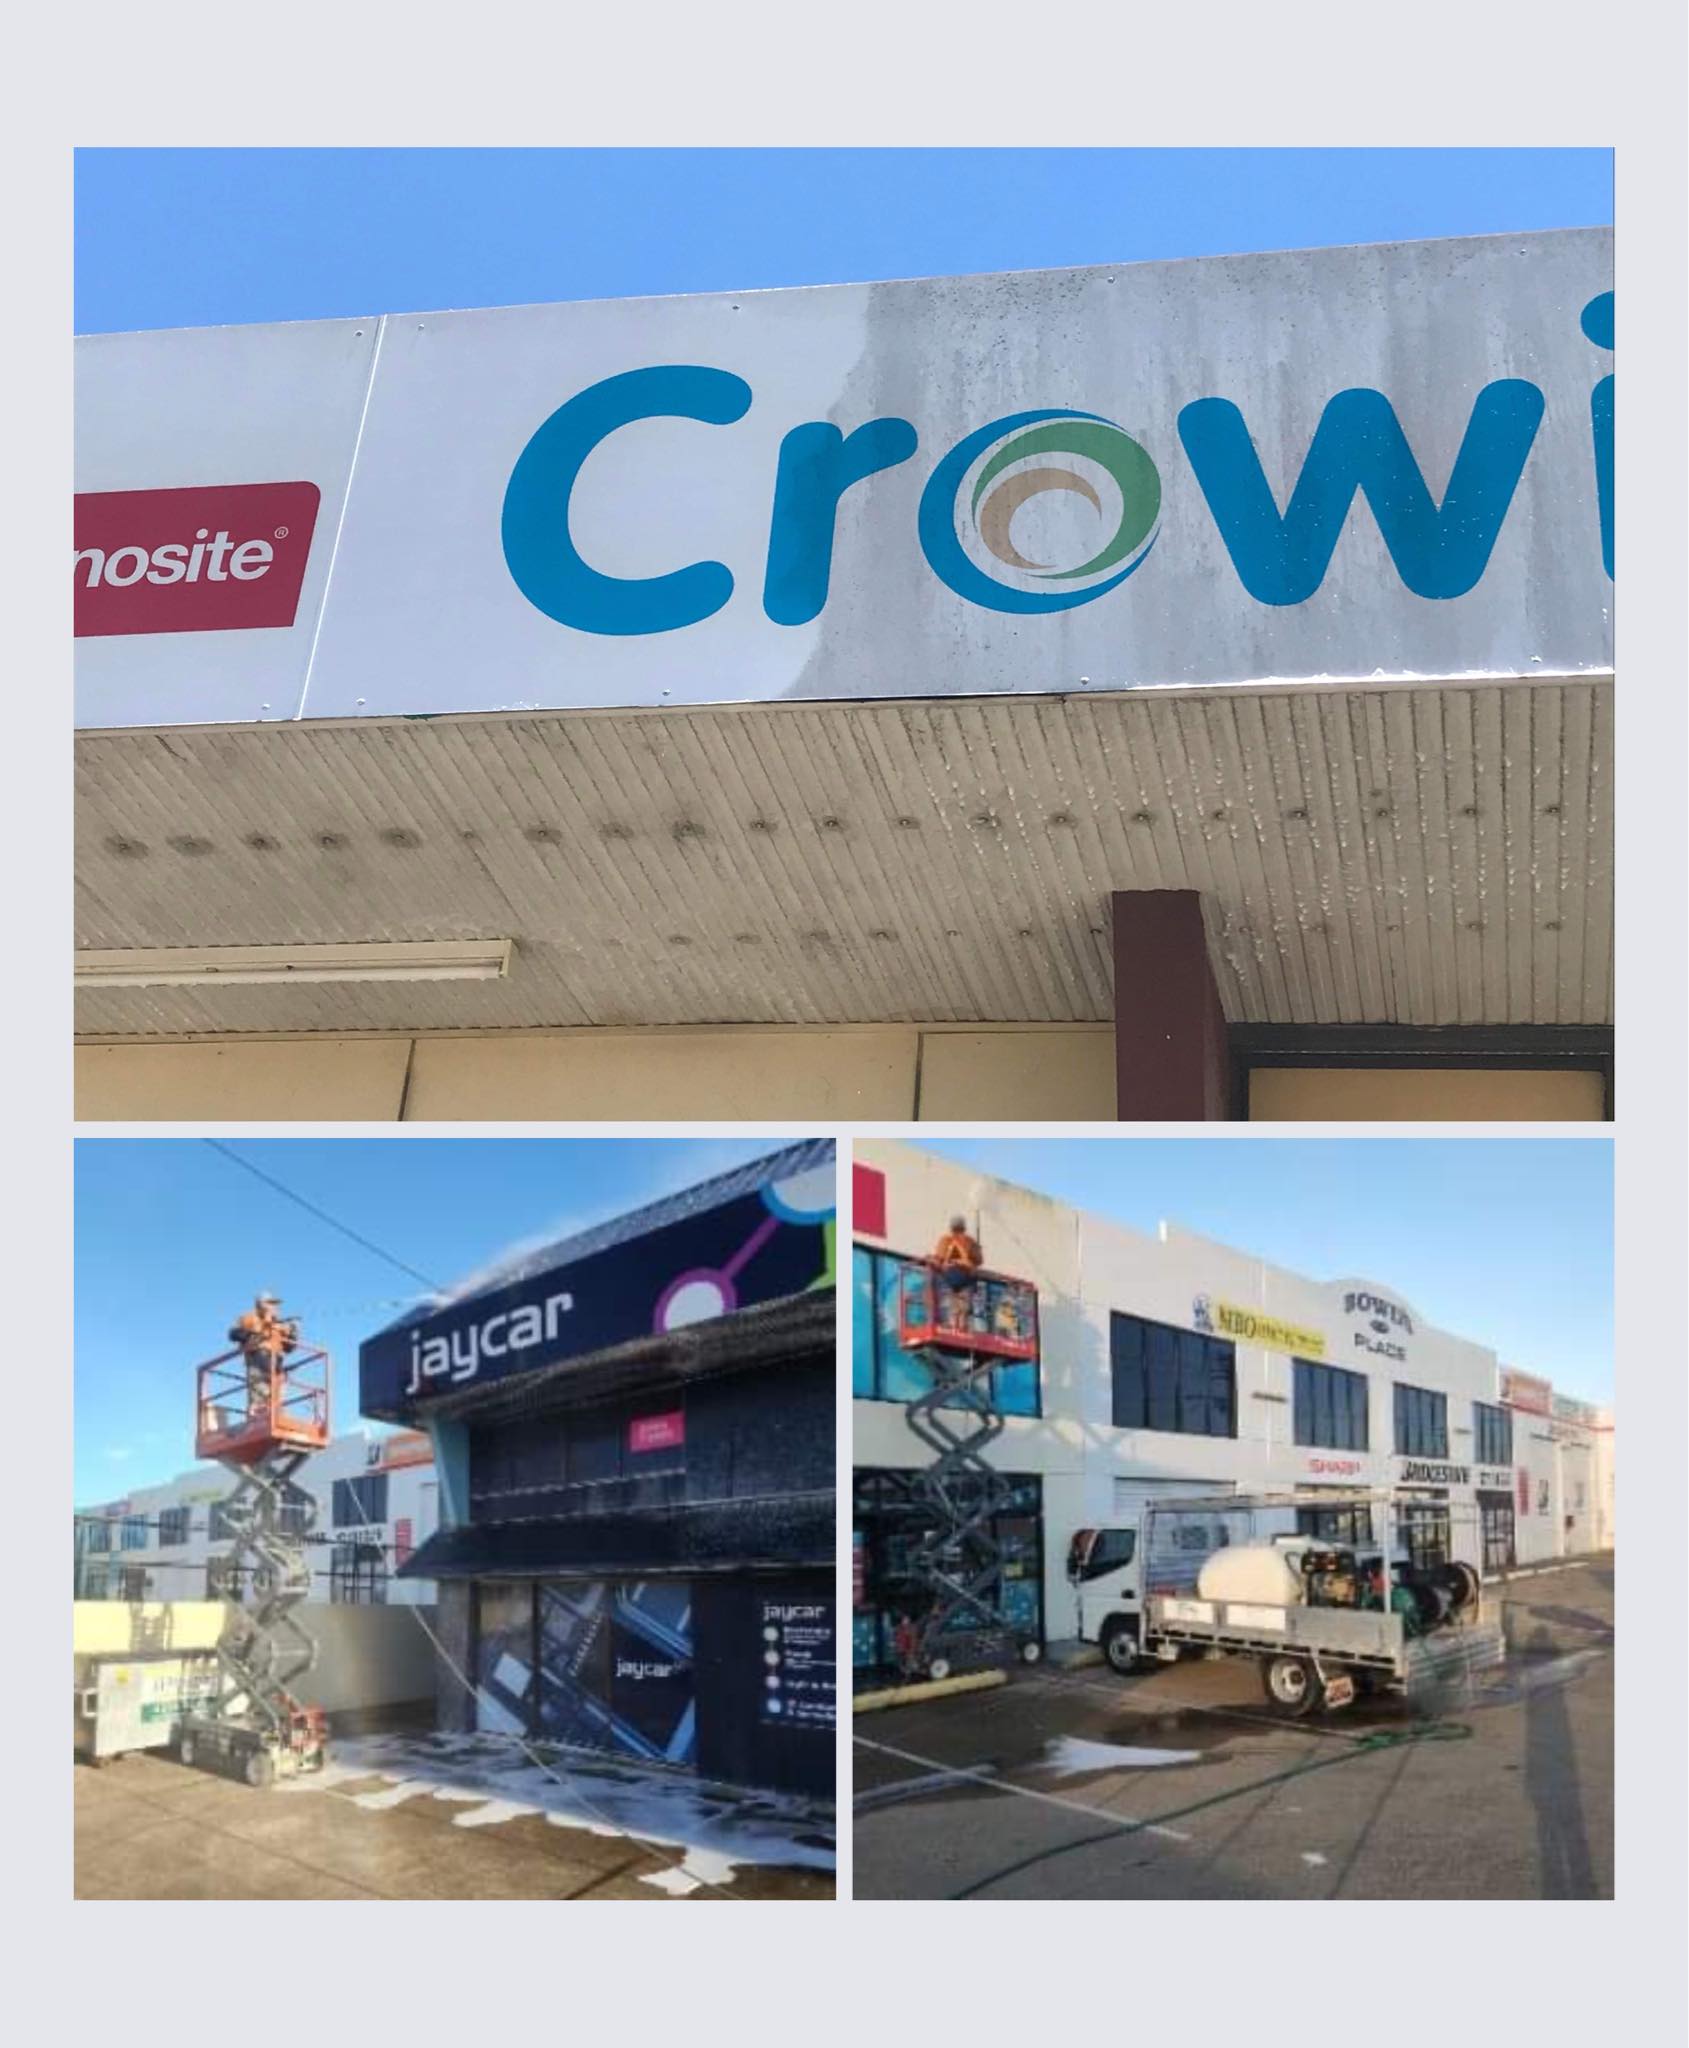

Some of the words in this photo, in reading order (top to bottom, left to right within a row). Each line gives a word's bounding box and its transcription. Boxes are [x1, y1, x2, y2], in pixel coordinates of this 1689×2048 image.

[406, 1293, 574, 1395] jaycar
[1354, 1332, 1407, 1361] PLACE
[763, 1601, 827, 1622] jaycar
[616, 1656, 673, 1680] jaycar
